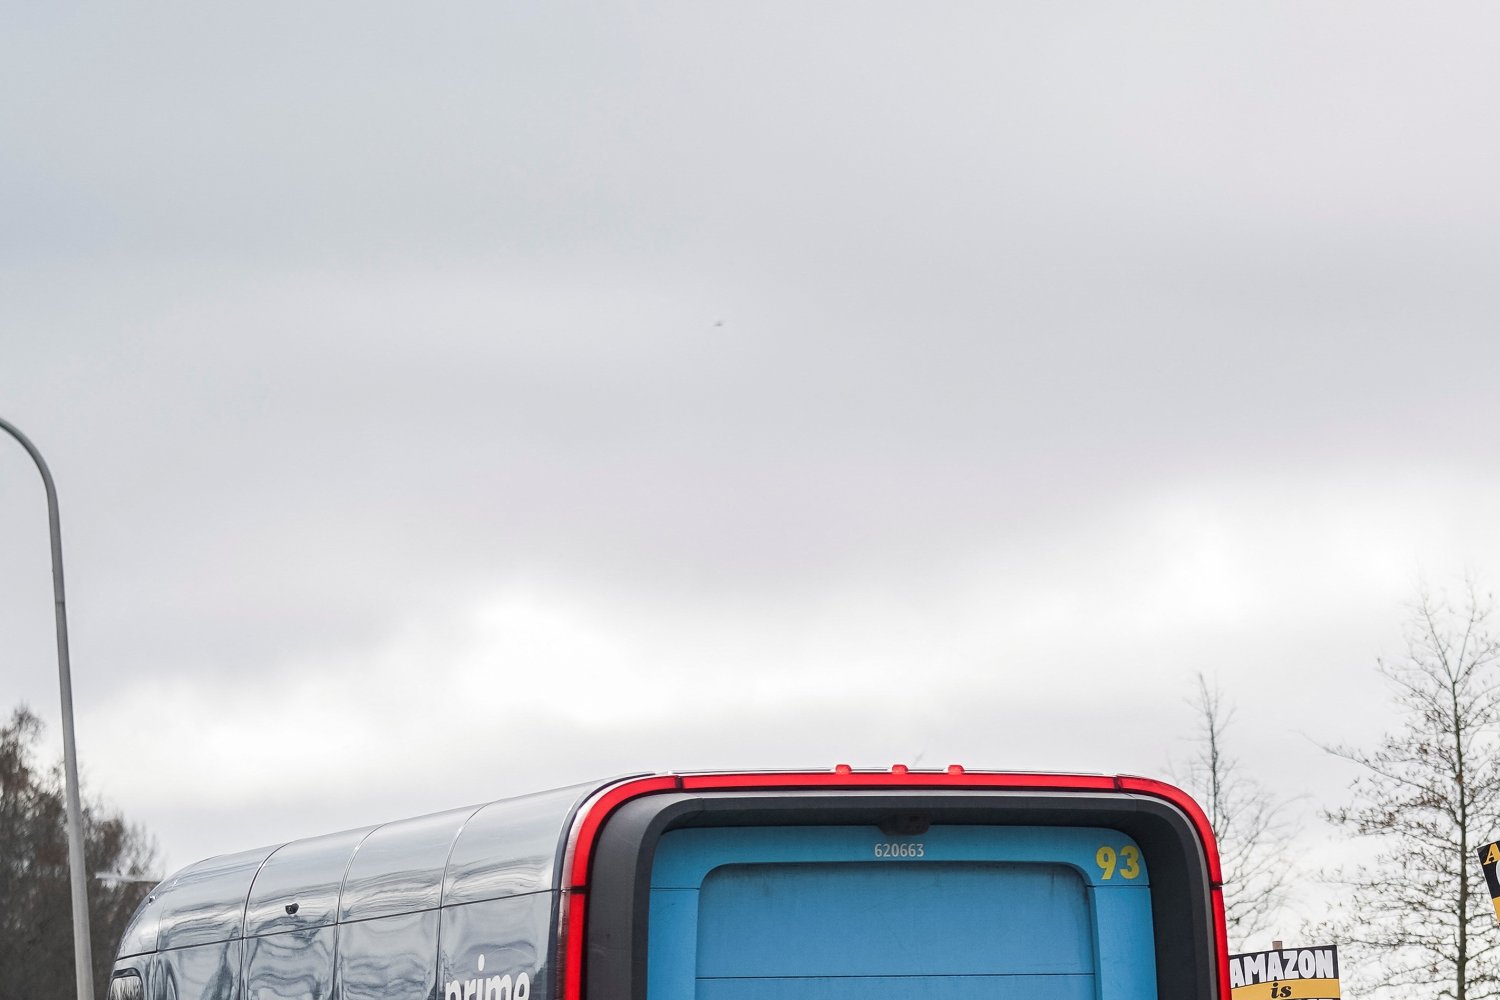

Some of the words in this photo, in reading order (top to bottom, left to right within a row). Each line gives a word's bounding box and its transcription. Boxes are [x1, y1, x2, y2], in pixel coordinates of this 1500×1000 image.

[874, 843, 925, 859] 620663
[1095, 844, 1141, 881] 93
[1229, 949, 1335, 989] AMAZON
[1270, 982, 1292, 999] is
